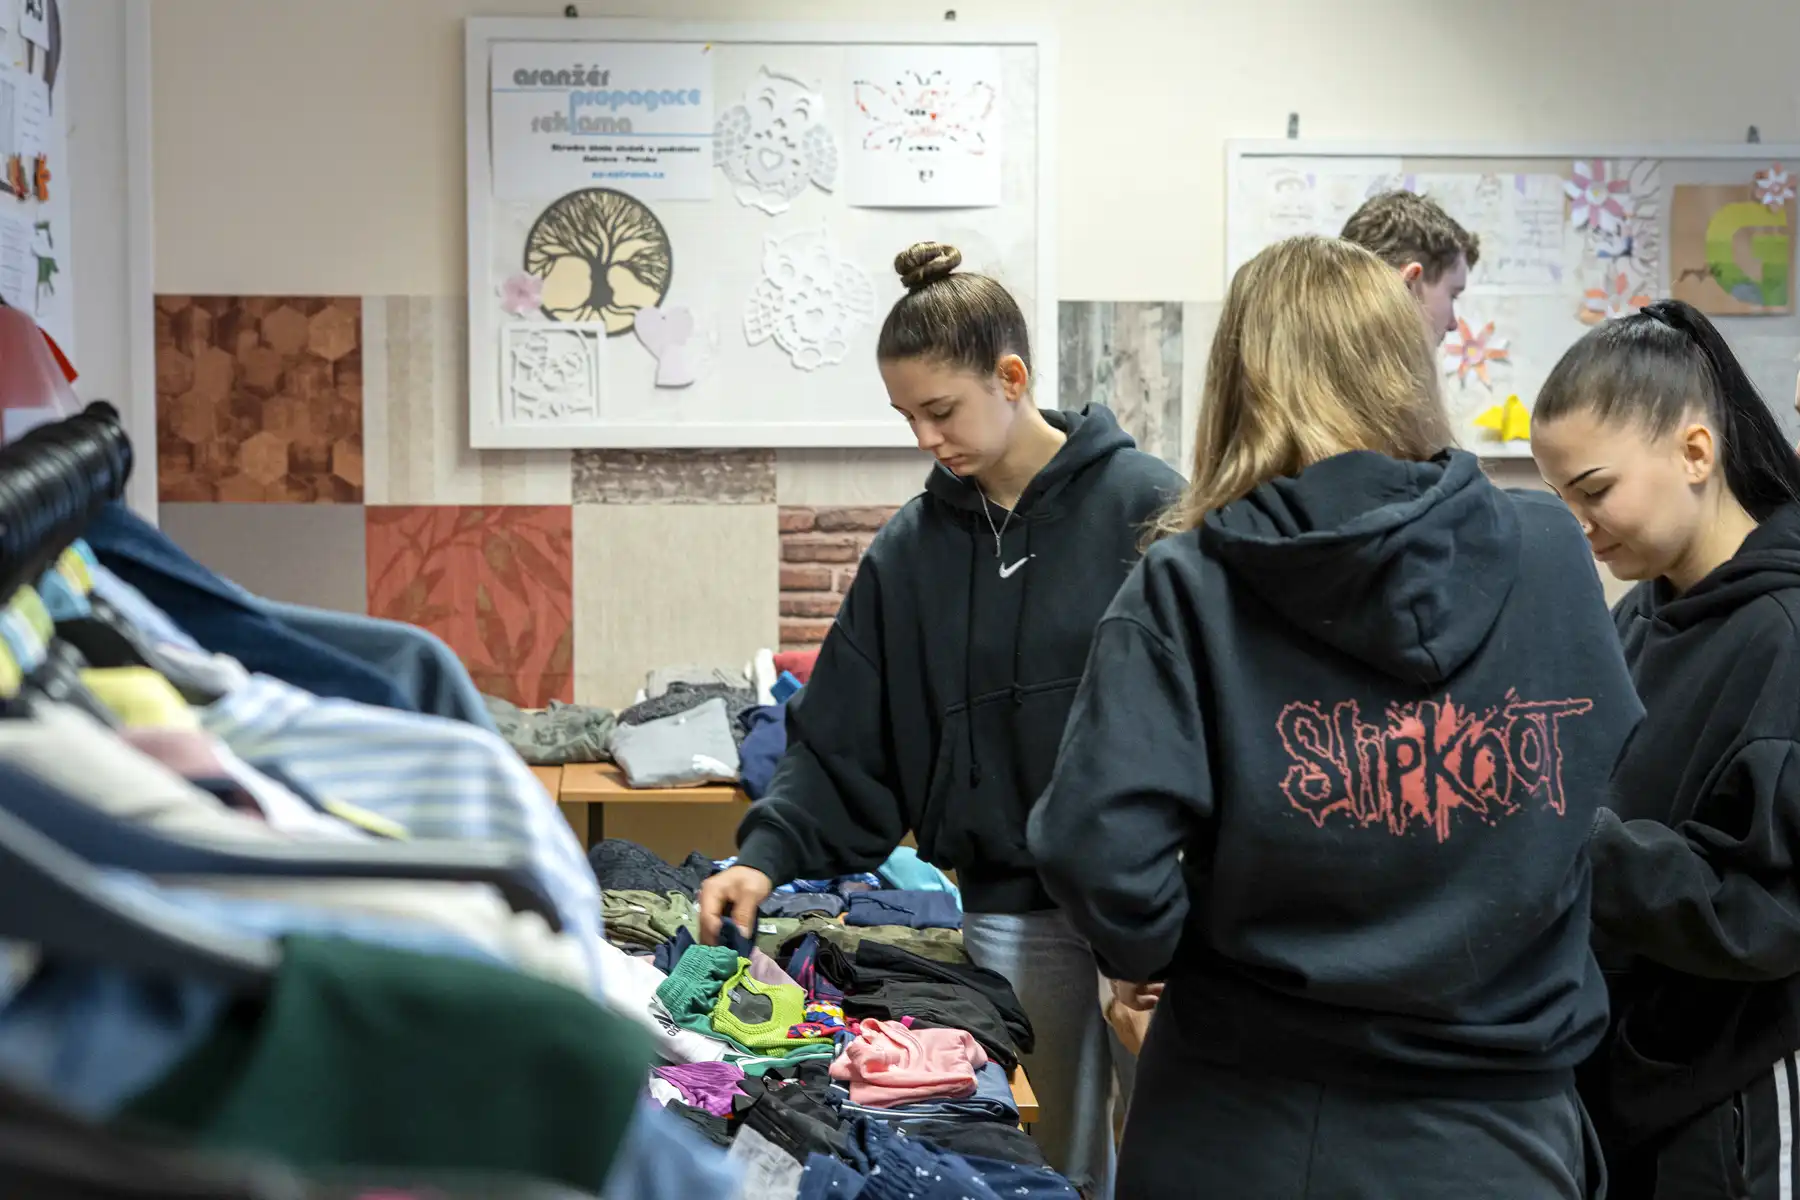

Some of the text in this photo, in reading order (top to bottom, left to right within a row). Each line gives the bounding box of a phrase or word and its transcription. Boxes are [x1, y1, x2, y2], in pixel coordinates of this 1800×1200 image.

[513, 64, 610, 87] aranžér
[570, 88, 702, 118] propagace
[531, 111, 633, 135] reklama
